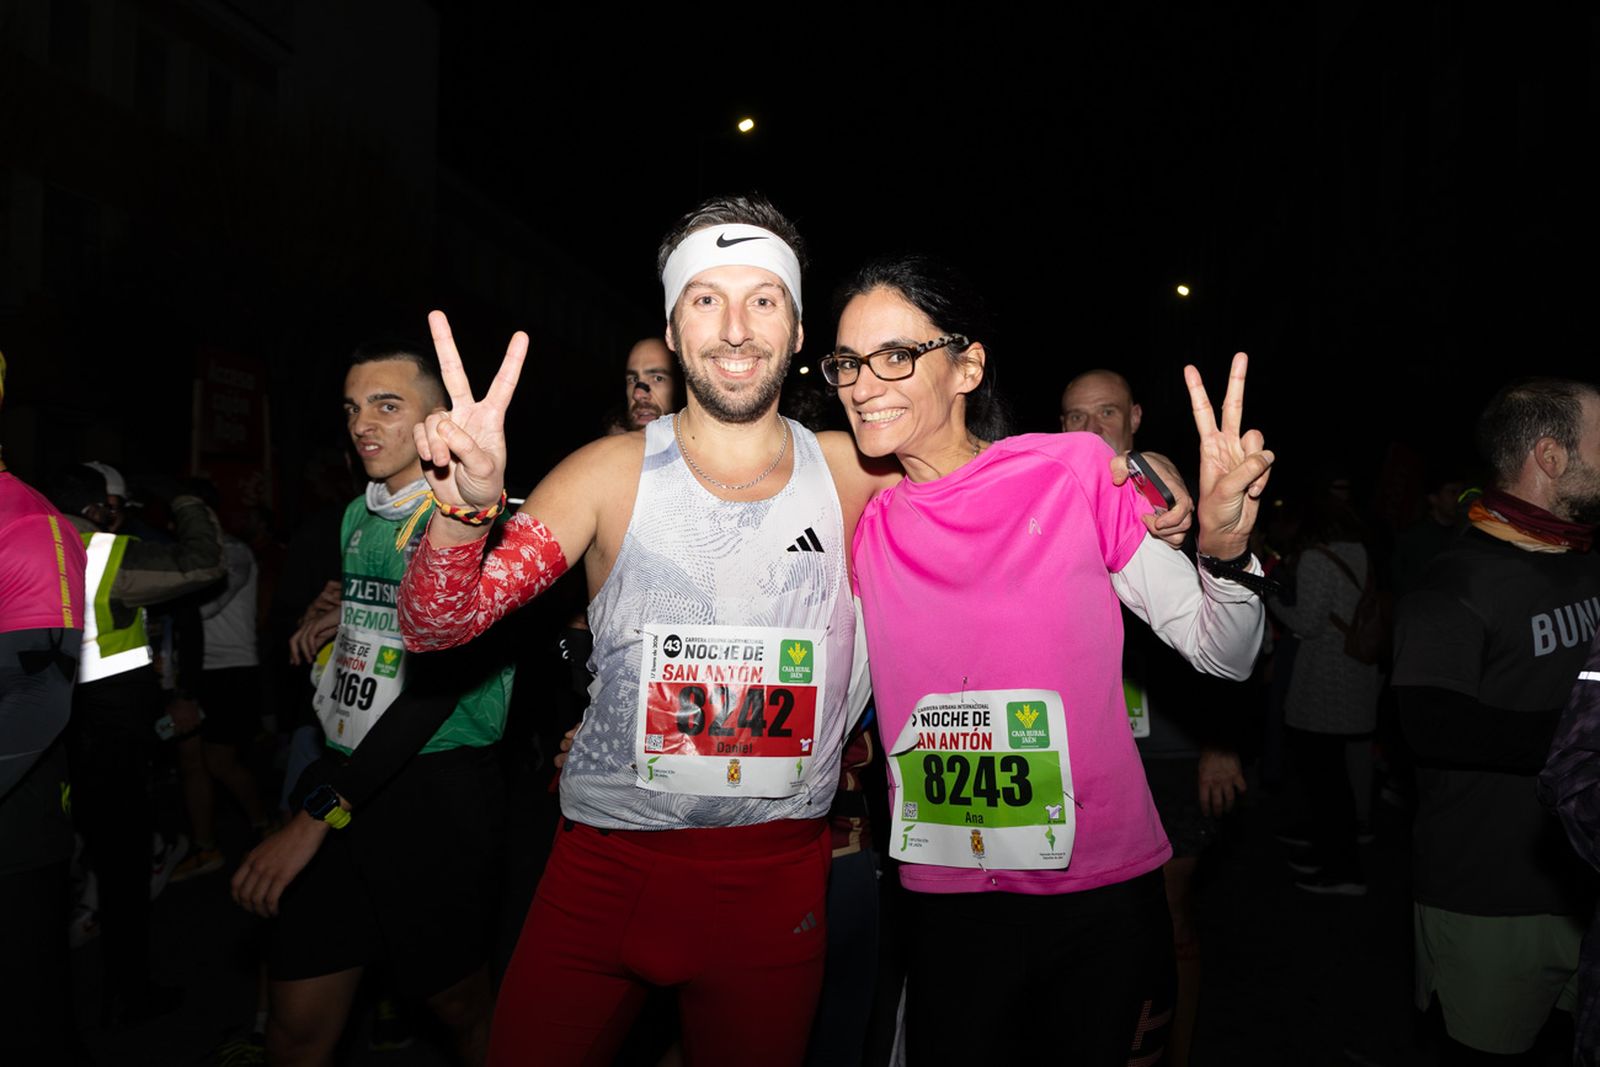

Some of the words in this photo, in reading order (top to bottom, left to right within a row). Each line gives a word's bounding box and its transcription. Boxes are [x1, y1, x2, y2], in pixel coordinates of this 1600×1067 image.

[664, 639, 681, 652] 43
[743, 646, 764, 661] DE
[662, 663, 699, 681] SAN
[676, 686, 794, 737] 8242
[917, 705, 939, 713] CARRERA
[920, 711, 969, 727] NOCHE
[972, 711, 991, 727] DE
[918, 732, 937, 749] AN
[939, 727, 992, 750] ANTÓN
[716, 741, 753, 754] Daniel
[923, 754, 1033, 808] 8243
[965, 811, 985, 824] Ana
